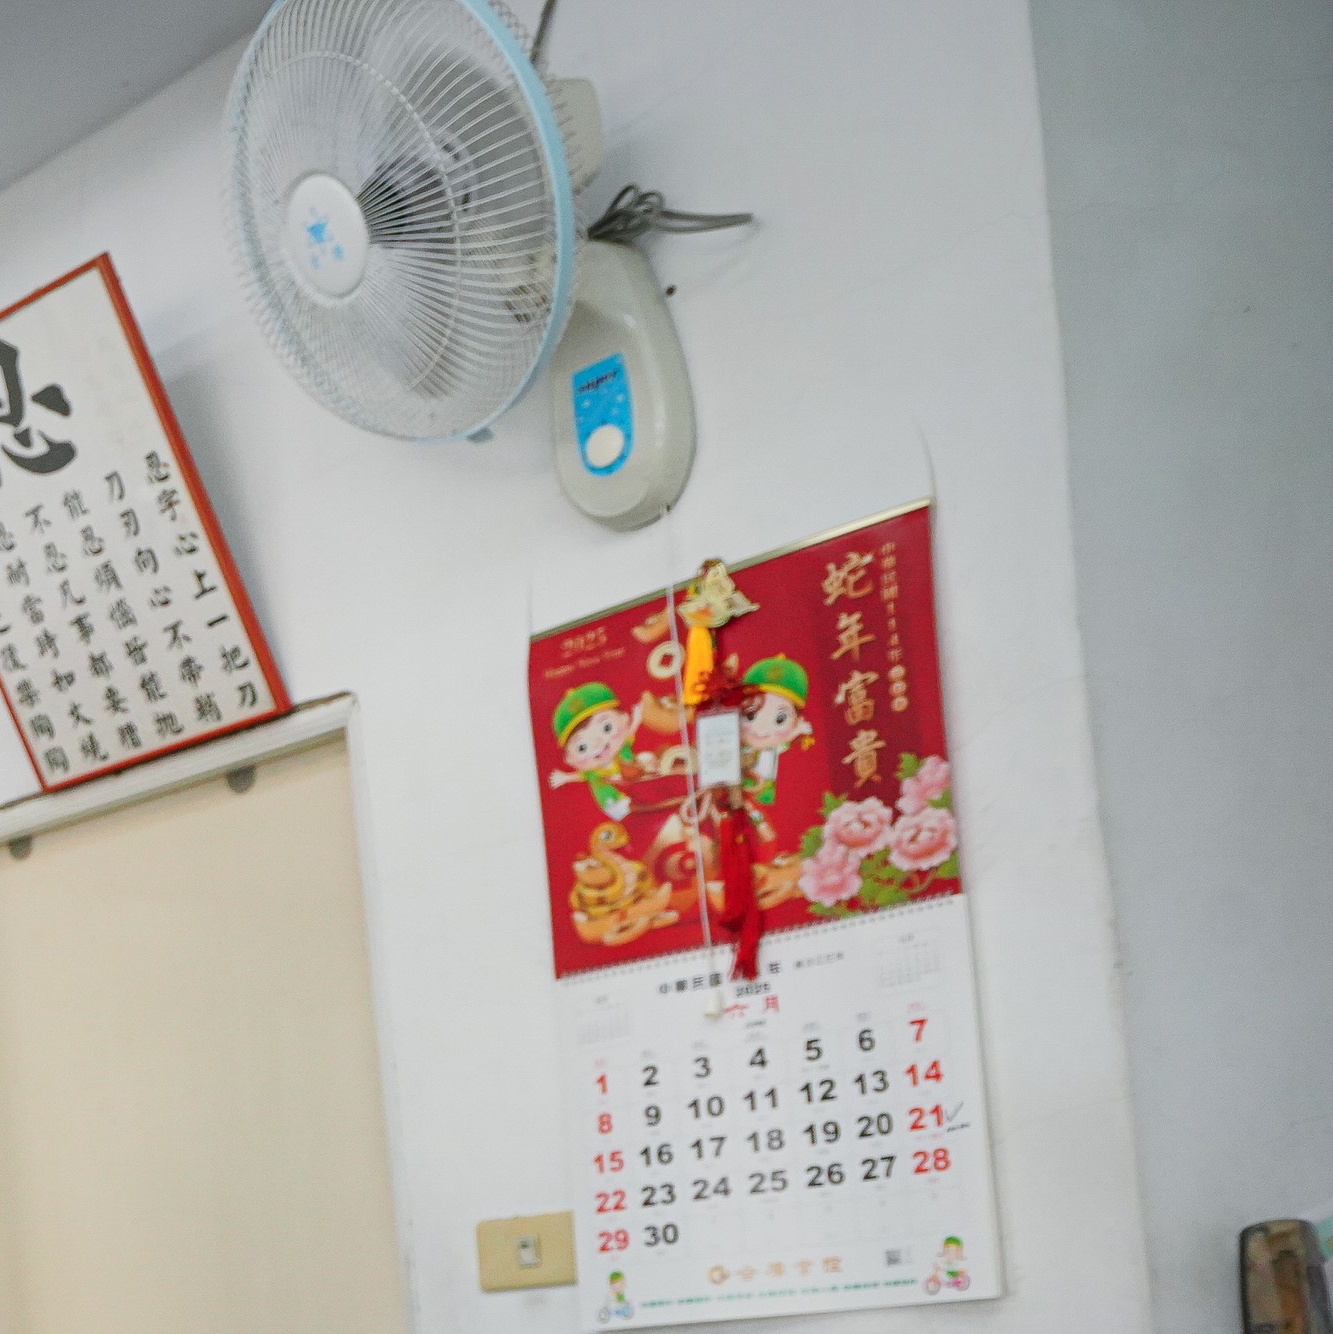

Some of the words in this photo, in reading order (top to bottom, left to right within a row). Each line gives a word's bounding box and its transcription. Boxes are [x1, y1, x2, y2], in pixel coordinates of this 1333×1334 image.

[145, 450, 258, 709] 忍字心上一把刀
[821, 552, 886, 788] 蛇年富貴
[597, 1074, 608, 1095] 1
[642, 1066, 659, 1086] 2
[694, 1057, 711, 1078] 3
[750, 1048, 767, 1068] 4
[806, 1039, 822, 1060] 5
[858, 1029, 875, 1051] 6
[910, 1019, 927, 1042] 7
[598, 1113, 613, 1134] 8
[645, 1105, 661, 1126] 9
[688, 1096, 725, 1119] 10
[744, 1087, 778, 1112] 11
[800, 1079, 837, 1103] 12
[854, 1070, 889, 1095] 13
[905, 1060, 943, 1086] 14
[593, 1150, 624, 1174] 15
[640, 1143, 673, 1166] 16
[691, 1136, 727, 1161] 17
[747, 1129, 785, 1153] 18
[804, 1121, 841, 1146] 19
[857, 1112, 893, 1138] 20
[908, 1104, 944, 1131] 21
[595, 1190, 626, 1214] 22
[641, 1184, 676, 1208] 23
[693, 1176, 732, 1200] 24
[748, 1169, 788, 1195] 25
[806, 1163, 845, 1188] 26
[862, 1155, 897, 1182] 27
[912, 1148, 951, 1174] 28
[598, 1229, 629, 1254] 29
[644, 1223, 679, 1247] 30
